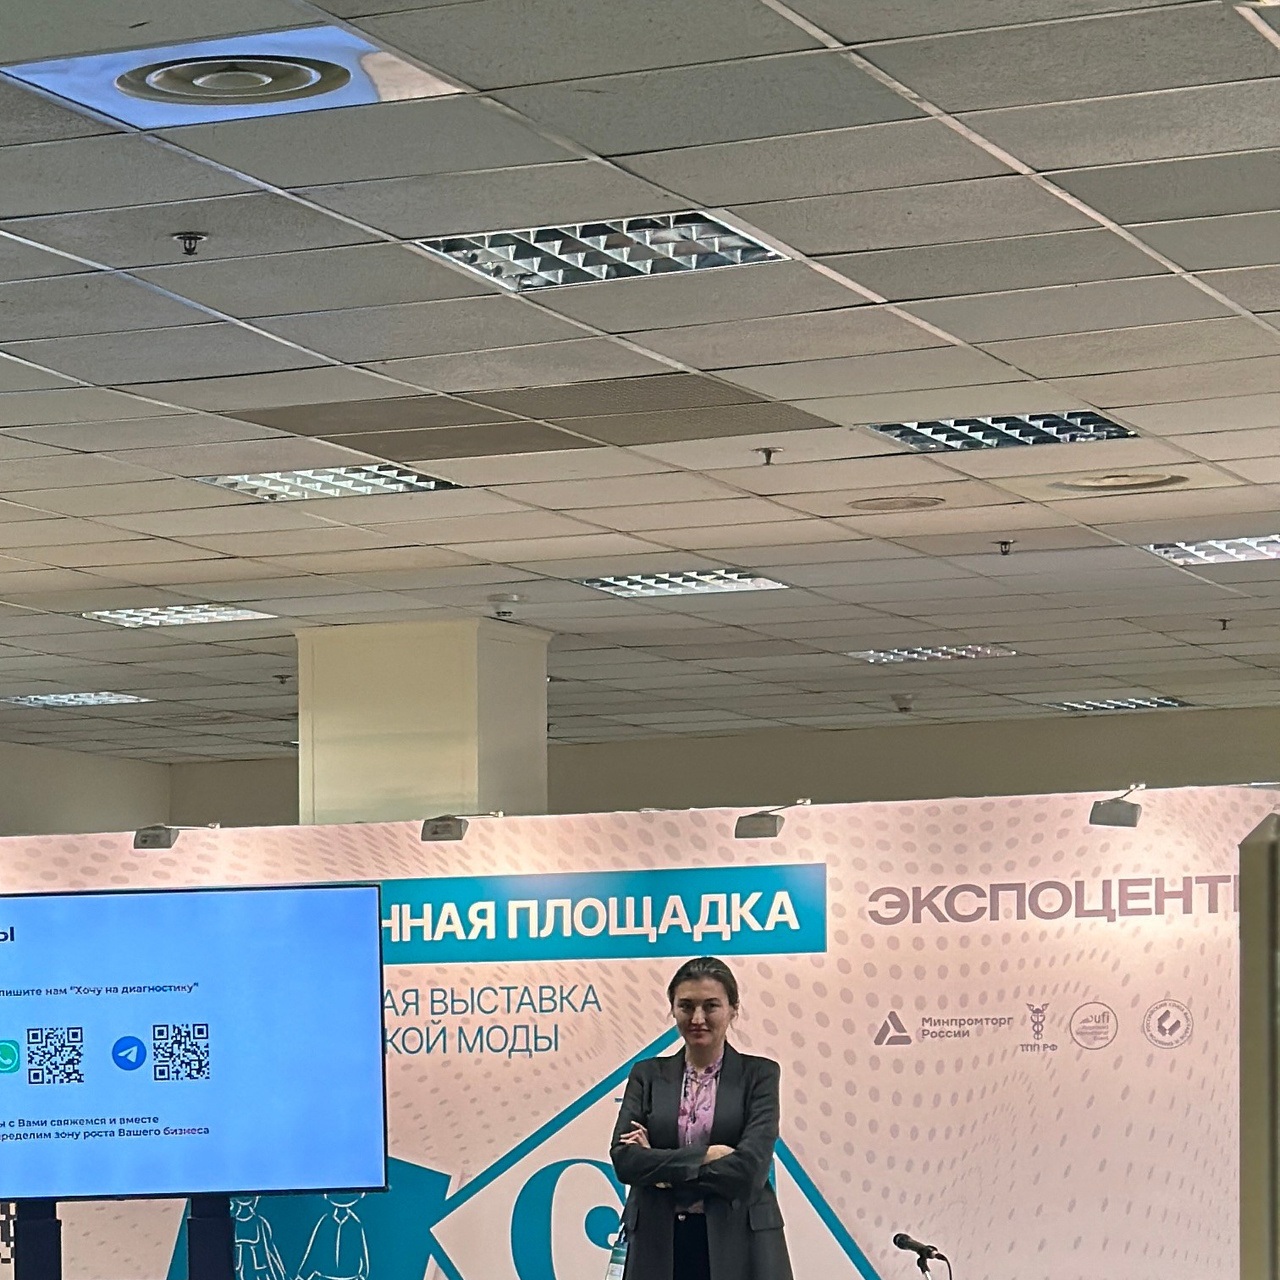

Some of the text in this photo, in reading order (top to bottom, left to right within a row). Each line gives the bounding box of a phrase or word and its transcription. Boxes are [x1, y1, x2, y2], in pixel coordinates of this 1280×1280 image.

[867, 873, 1239, 926] ЭКСПОЦЕНТ
[507, 891, 801, 942] ПЛОЩАДКА
[45, 986, 68, 996] нам
[105, 985, 119, 994] на
[430, 983, 602, 1016] ВЫСТАВКА
[921, 1016, 1014, 1028] Минпромторг
[921, 1028, 970, 1039] России
[457, 1023, 559, 1059] МОДЫ
[1020, 1043, 1058, 1053] ТПП РФ
[17, 1118, 48, 1127] Вами
[50, 1117, 106, 1127] свяжемся
[119, 1115, 159, 1125] вместе
[54, 1130, 80, 1141] зону
[83, 1129, 116, 1140] роста
[118, 1127, 161, 1138] Вашего
[163, 1126, 210, 1136] бизнеса
